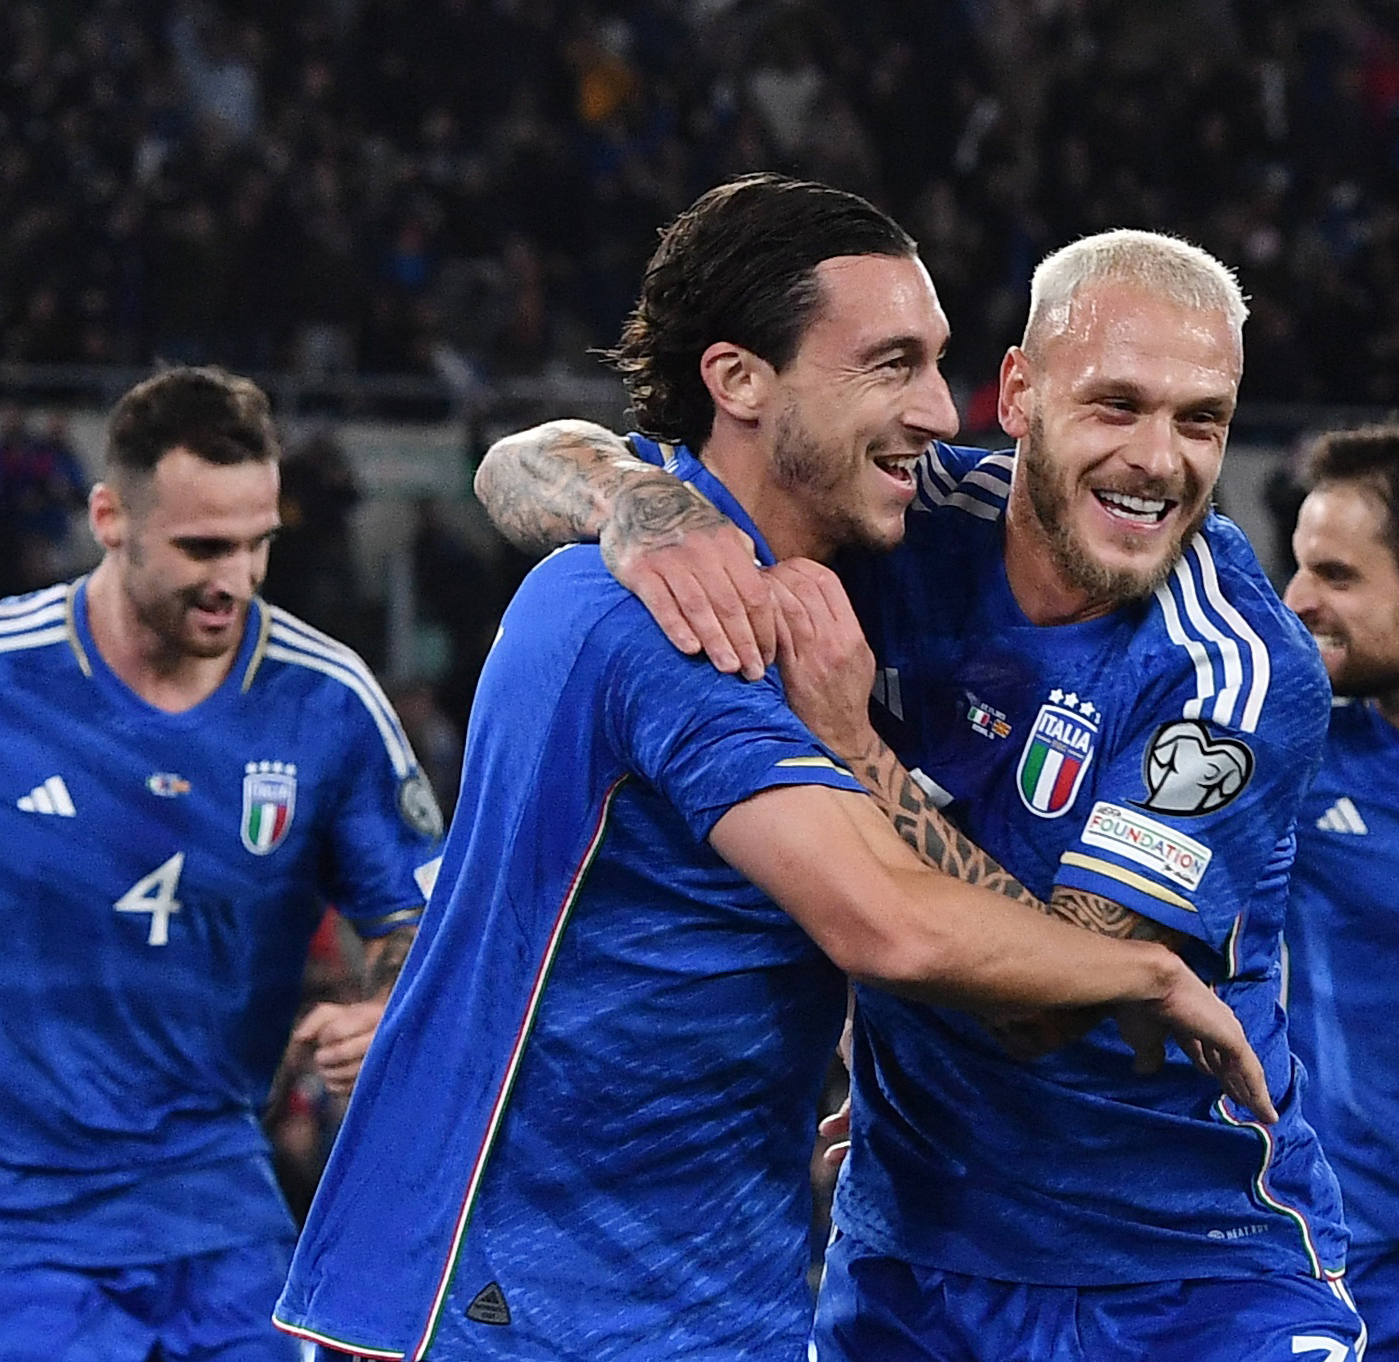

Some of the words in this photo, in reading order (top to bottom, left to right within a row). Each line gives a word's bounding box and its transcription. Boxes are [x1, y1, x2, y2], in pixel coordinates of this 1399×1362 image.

[1038, 712, 1091, 753] ITALIA
[1089, 815, 1204, 875] FOUNDATION
[113, 851, 185, 947] 4
